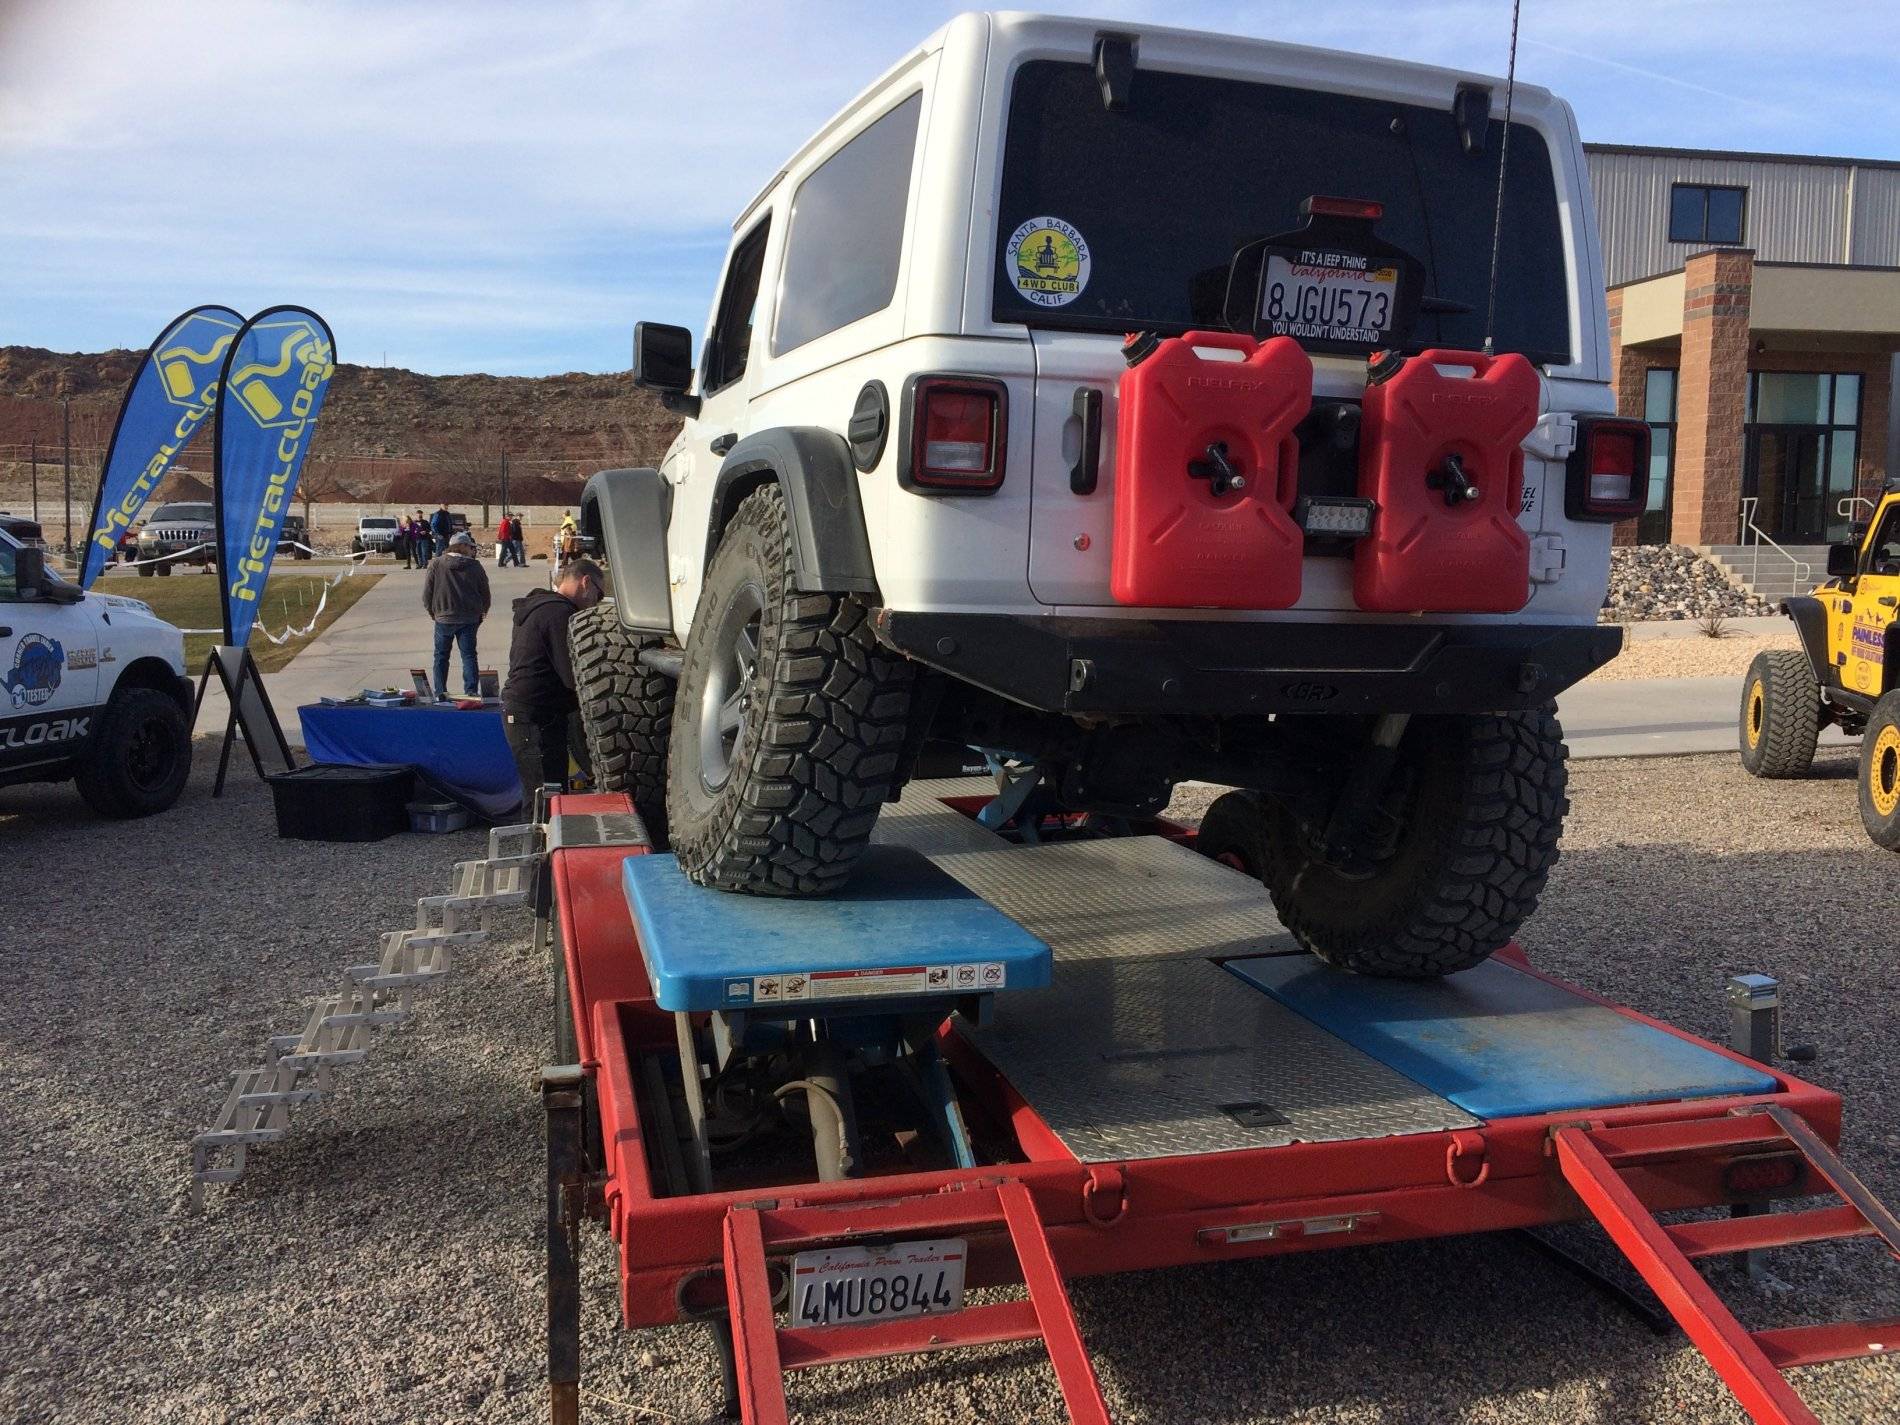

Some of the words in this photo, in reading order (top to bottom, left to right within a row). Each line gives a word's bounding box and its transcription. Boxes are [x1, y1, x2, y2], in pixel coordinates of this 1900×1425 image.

[1007, 221, 1037, 257] SANTA
[1046, 218, 1088, 262] BARBARA
[1301, 251, 1316, 264] IT'S
[1317, 253, 1322, 265] A
[1322, 253, 1341, 268] JEEP
[1341, 255, 1367, 270] THING
[1290, 262, 1375, 284] California
[1022, 280, 1046, 289] 4WD
[1051, 281, 1075, 291] CLUB
[1267, 282, 1389, 329] 8JGU573
[1272, 320, 1288, 335] YOU
[1289, 322, 1328, 338] WOULDN'T
[1329, 327, 1379, 343] UNDERSTAND
[818, 1259, 870, 1274] California
[907, 1253, 941, 1264] Trailer
[801, 1271, 952, 1323] 4MU8844
